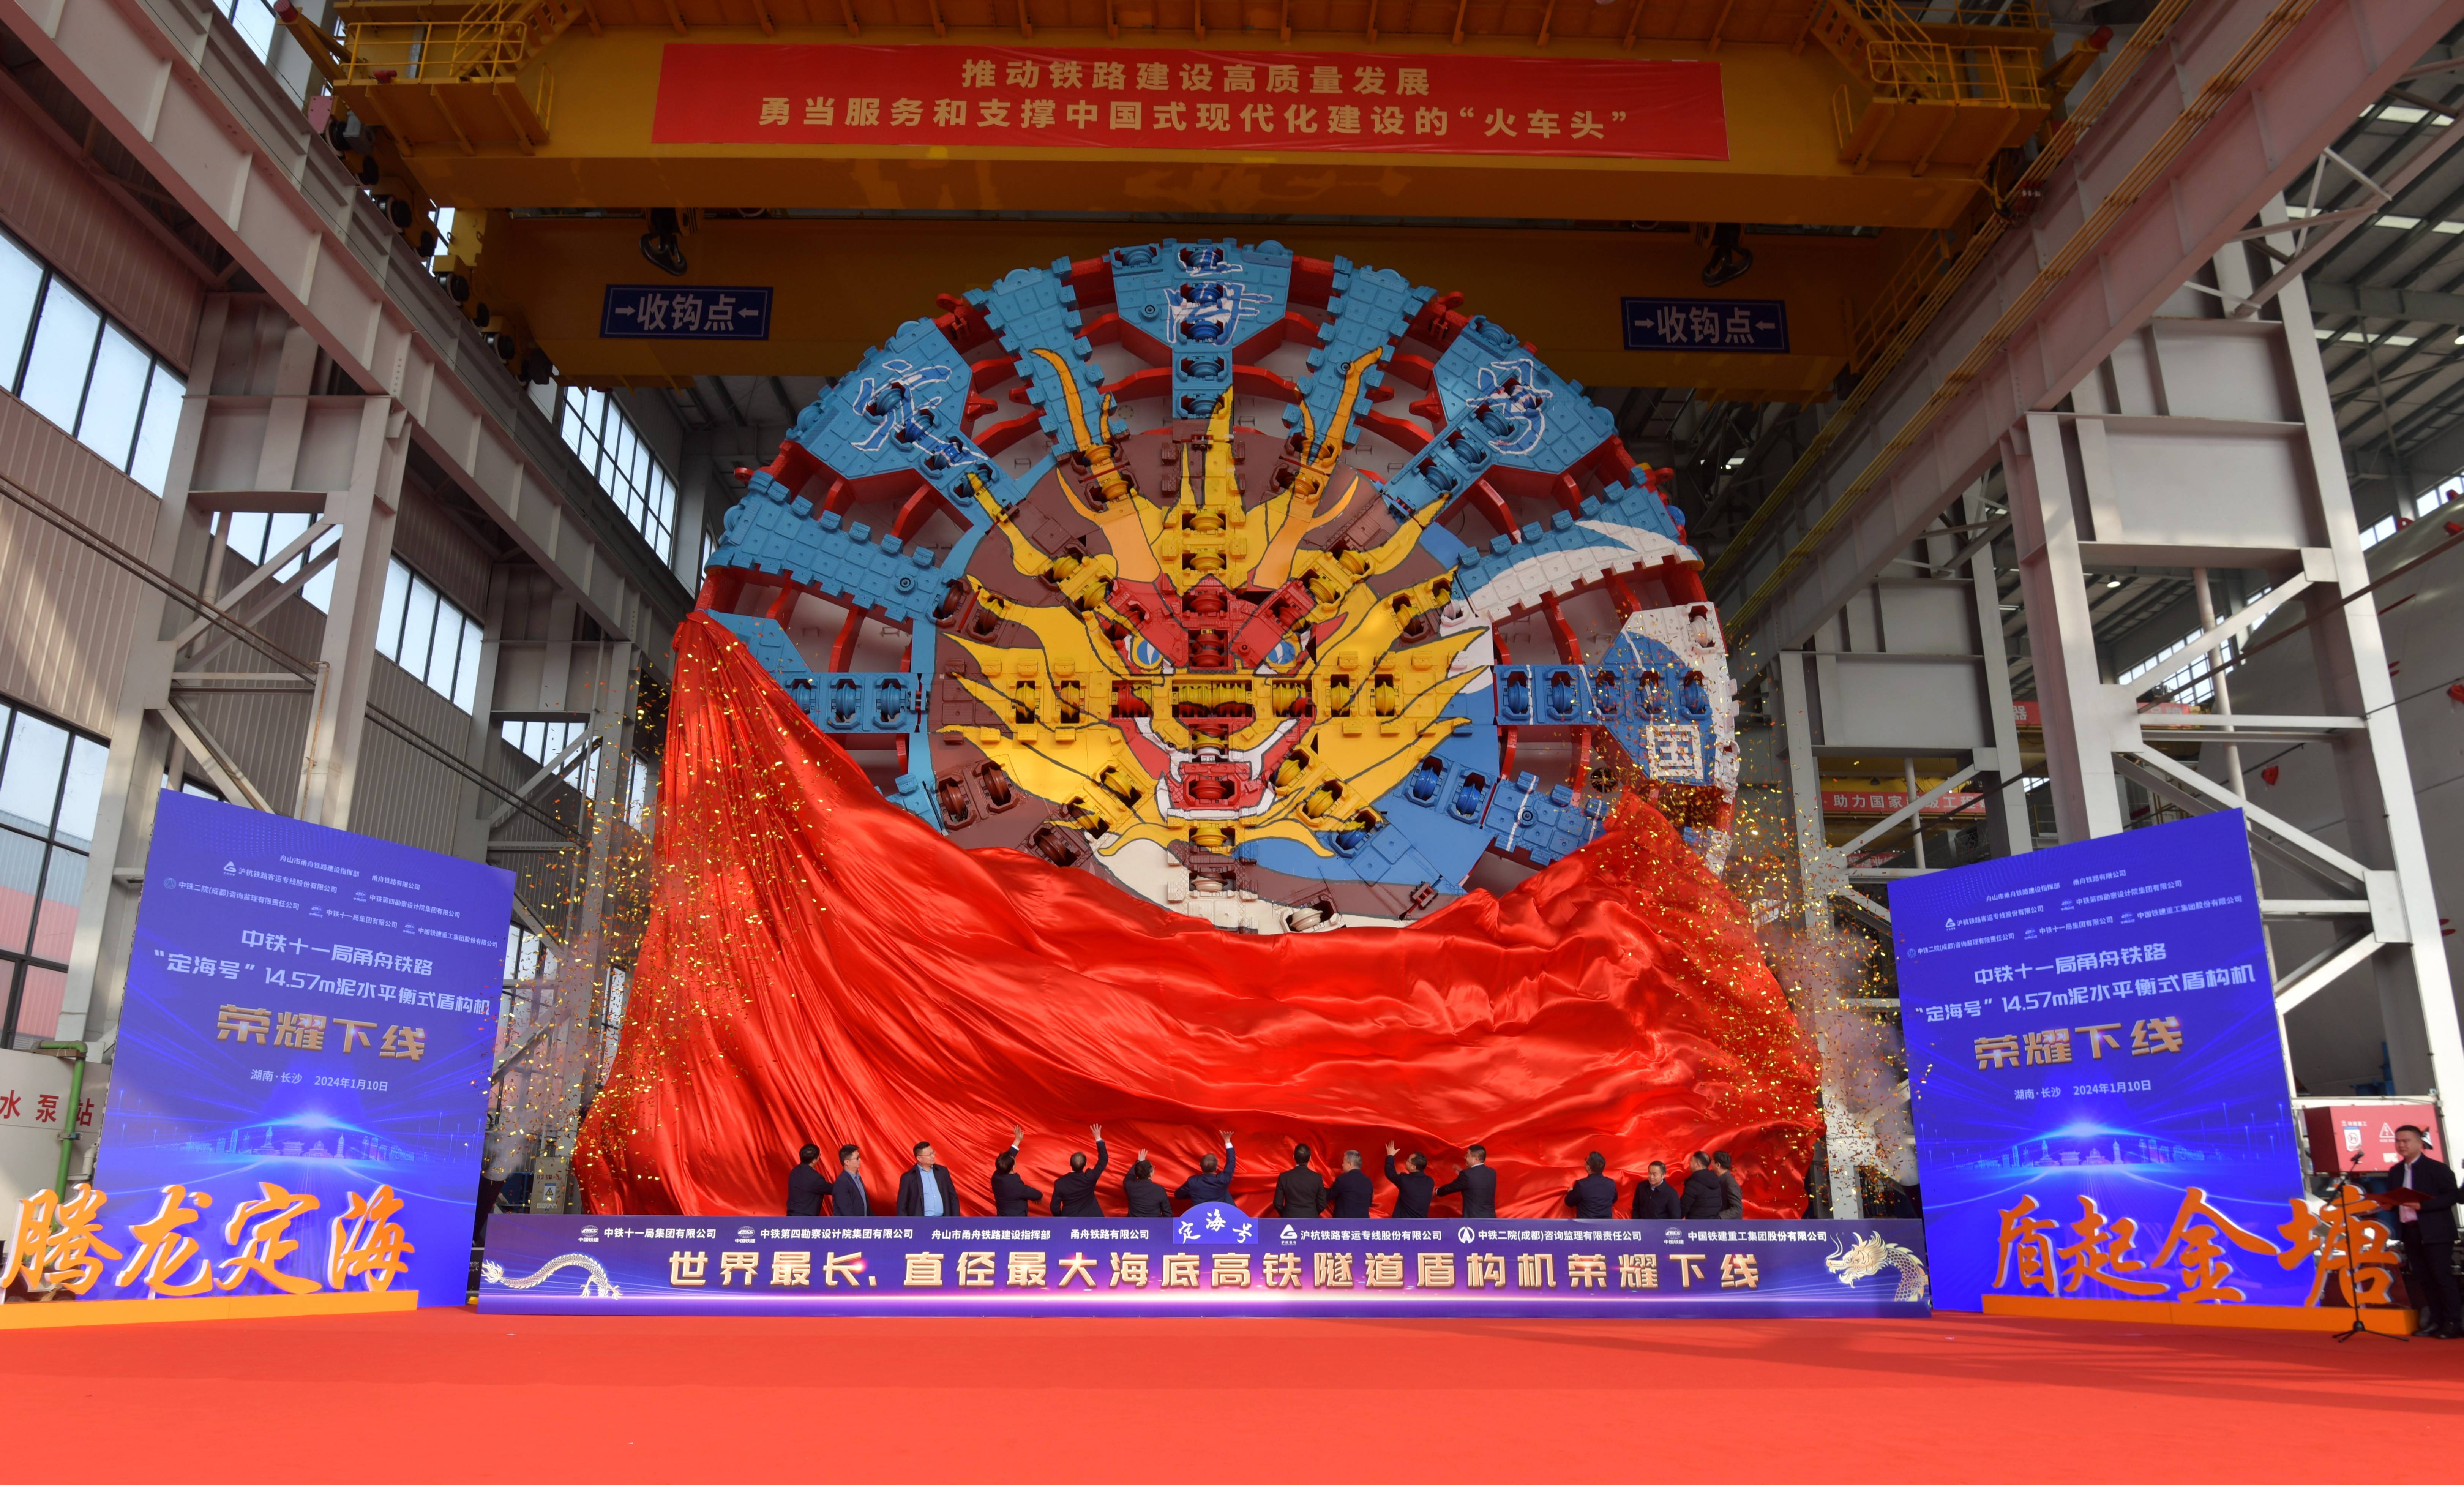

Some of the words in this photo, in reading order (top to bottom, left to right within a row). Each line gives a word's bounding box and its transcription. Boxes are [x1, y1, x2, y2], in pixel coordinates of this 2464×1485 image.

[961, 58, 1431, 96] 推动铁路建设高质量发展
[759, 96, 1629, 140] 勇当服务和支撑中国式现代化建设的“火车头”
[637, 293, 736, 331] 收钩点
[1657, 306, 1754, 344] 收钩点
[1834, 794, 1985, 809] 助力国家级工程
[279, 855, 360, 878] 舟山市甬舟铁路建设指挥部
[371, 874, 420, 891] 甬舟铁路有限公司
[1986, 882, 2060, 902] 舟山市甬舟铁路建设指挥部
[2073, 869, 2126, 886] 甬舟铁路有限公司
[238, 867, 338, 894] 沪杭铁路客运专线股份有限公司
[369, 894, 461, 919] 中铁第四勘察设计院集团有限公司
[1957, 905, 2044, 926] 沪杭铁路客运专线股份有限公司
[2076, 880, 2182, 906] 中铁第四勘察设计院集团有限公司
[326, 909, 398, 929] 中铁十一局集团有限公司
[418, 927, 498, 948] 中国铁建重工集团股份有限公司
[2039, 916, 2113, 935] 中铁十一局集团有限公司
[2137, 894, 2242, 919] 中国铁建重工集团股份有限公司
[241, 930, 433, 976] 中铁十一局甬舟铁路
[1974, 943, 2167, 985] 中铁十一局甬舟铁路
[217, 1004, 426, 1061] 荣耀下线
[1974, 1016, 2183, 1070] 荣耀下线
[250, 1069, 302, 1085] 湖南·长沙
[315, 1076, 388, 1093] 2024年1月10日
[2014, 1086, 2061, 1101] 湖南·长沙
[2073, 1079, 2151, 1096] 2024年1月10日
[0, 1090, 94, 1126] 水泵站
[1, 1182, 415, 1294] 腾龙定海
[604, 1227, 716, 1239] 中铁十一局集团有限公司
[760, 1228, 913, 1239] 中铁第四勘察设计院集团有限公司
[931, 1229, 1051, 1240] 舟山市甬舟铁路建设指挥部
[1071, 1229, 1149, 1240] 甬舟铁路有限公司
[1301, 1230, 1442, 1241] 沪杭铁路客运专线股份有限公司
[1478, 1229, 1642, 1242] 中铁二院(成都)咨询监理有限责任公司
[1688, 1231, 1827, 1242] 中国铁建重工集团股份有限公司
[1178, 1208, 1252, 1244] 定海号
[1992, 1183, 2401, 1307] 盾起金塘
